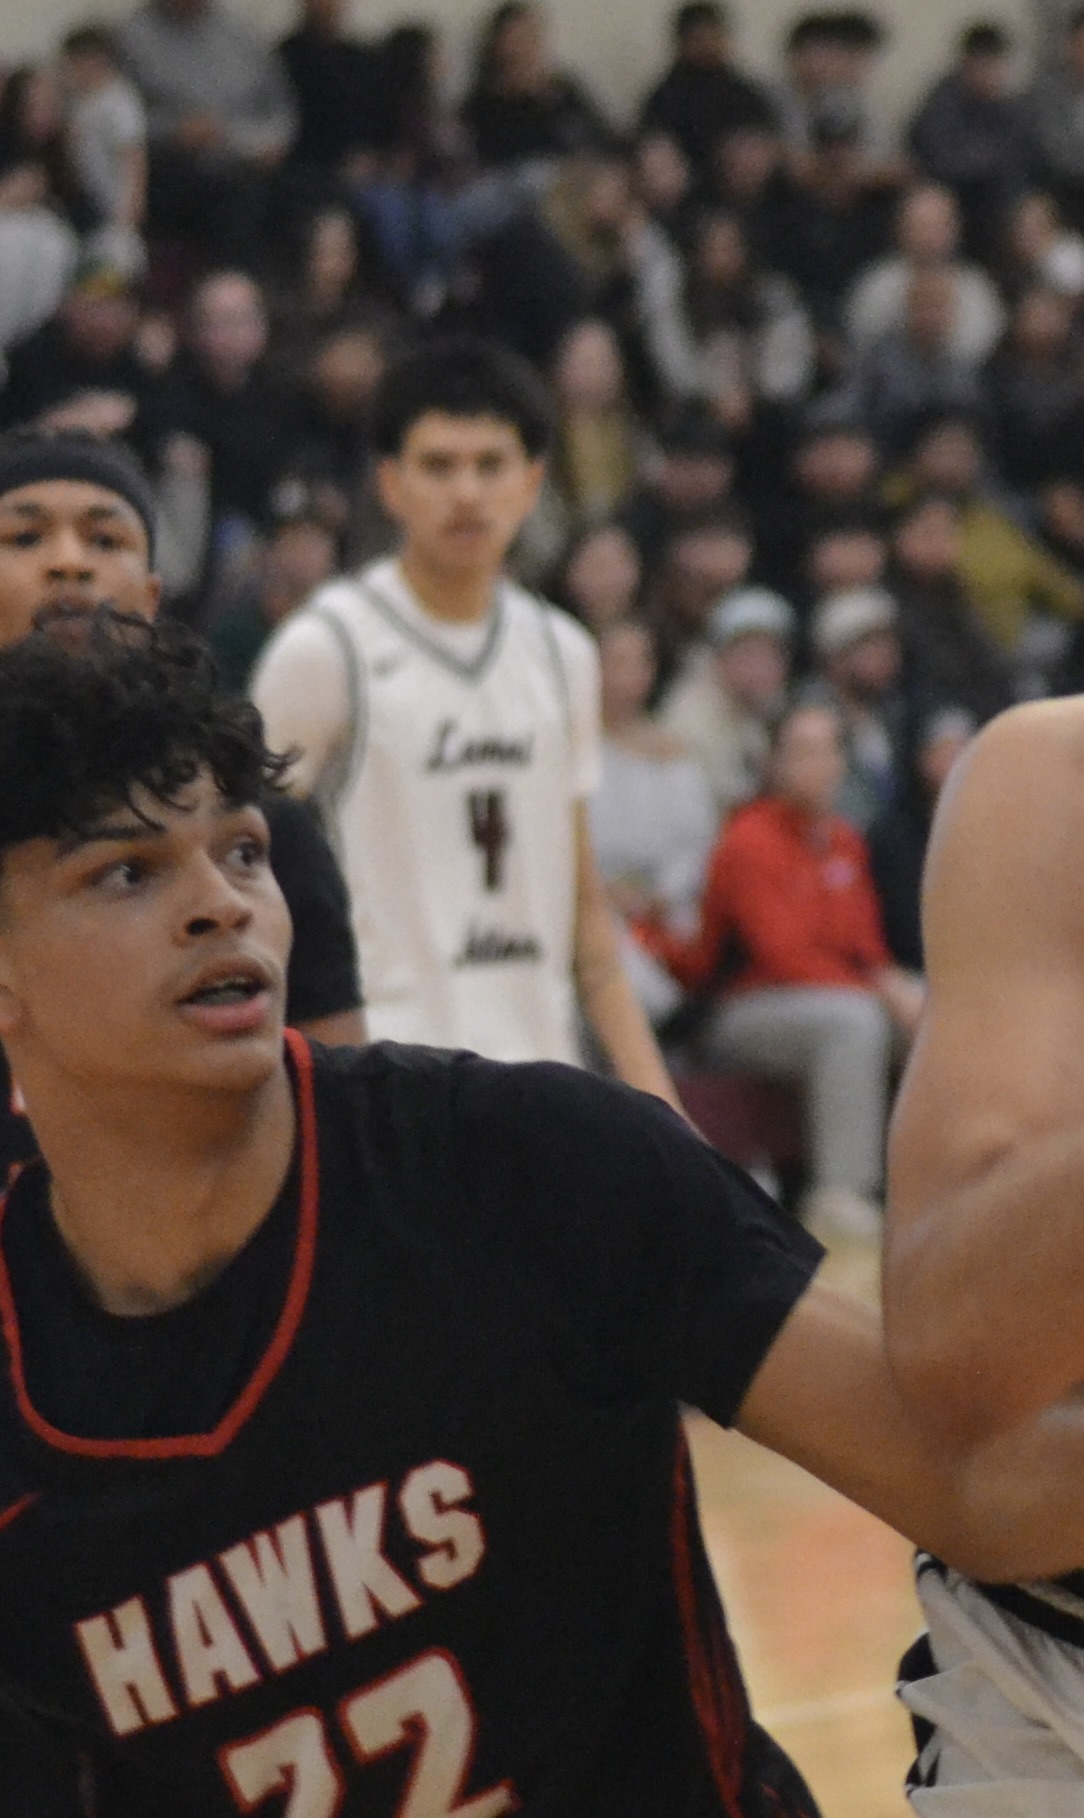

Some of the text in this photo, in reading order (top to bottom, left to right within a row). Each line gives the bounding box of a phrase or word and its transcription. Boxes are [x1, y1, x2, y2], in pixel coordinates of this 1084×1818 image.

[465, 789, 509, 891] 4
[73, 1458, 486, 1738] HAWKS
[217, 1646, 518, 1818] 22
